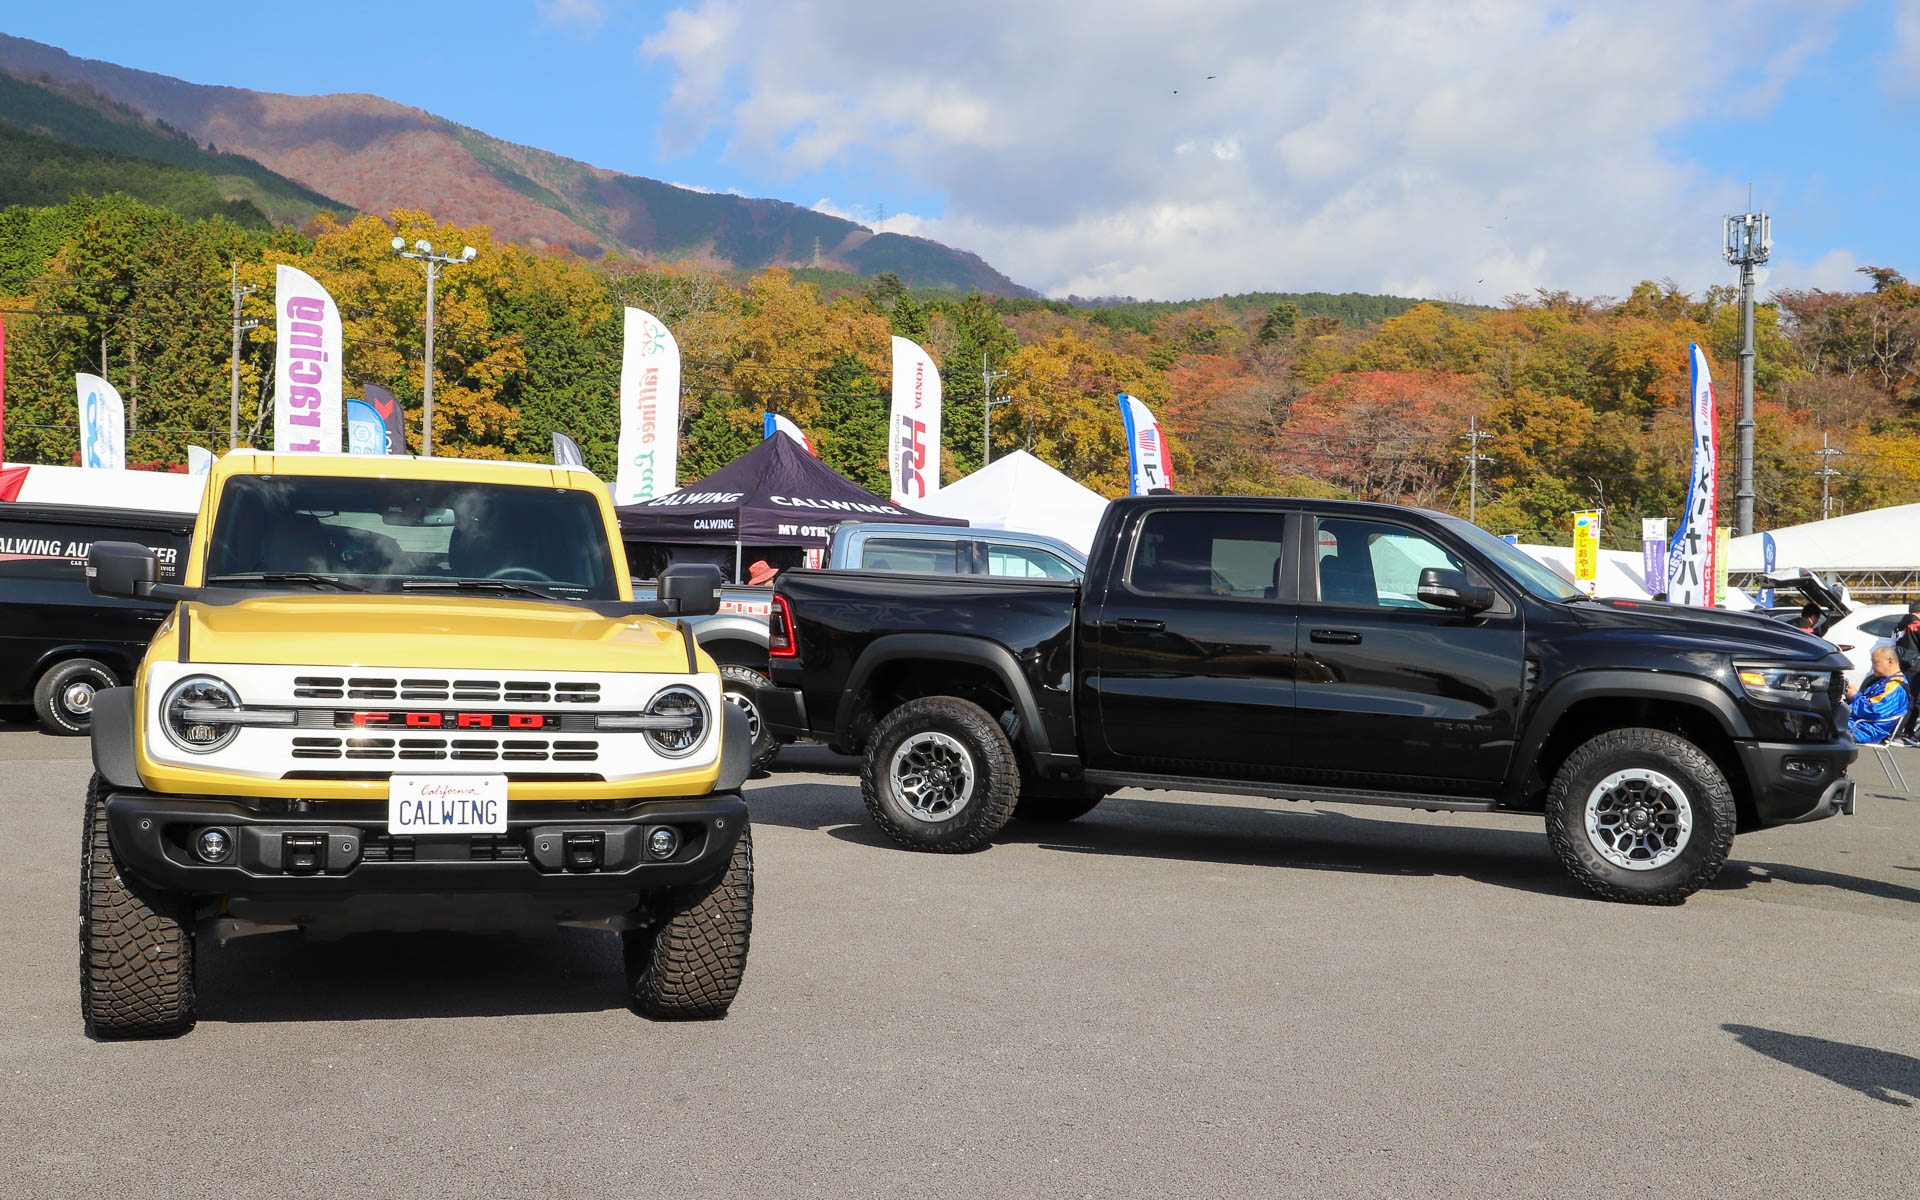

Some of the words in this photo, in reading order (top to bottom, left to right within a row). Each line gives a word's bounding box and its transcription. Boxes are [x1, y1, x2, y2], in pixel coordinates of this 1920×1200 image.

[914, 362, 924, 409] HONDA
[902, 415, 926, 499] HRC
[648, 492, 744, 506] CALWING
[770, 495, 905, 515] CALWING
[694, 519, 734, 529] CALWING
[778, 524, 798, 536] MY
[65, 541, 93, 558] AU
[353, 712, 544, 728] FORD
[421, 784, 480, 798] California
[399, 800, 497, 825] CALWING
